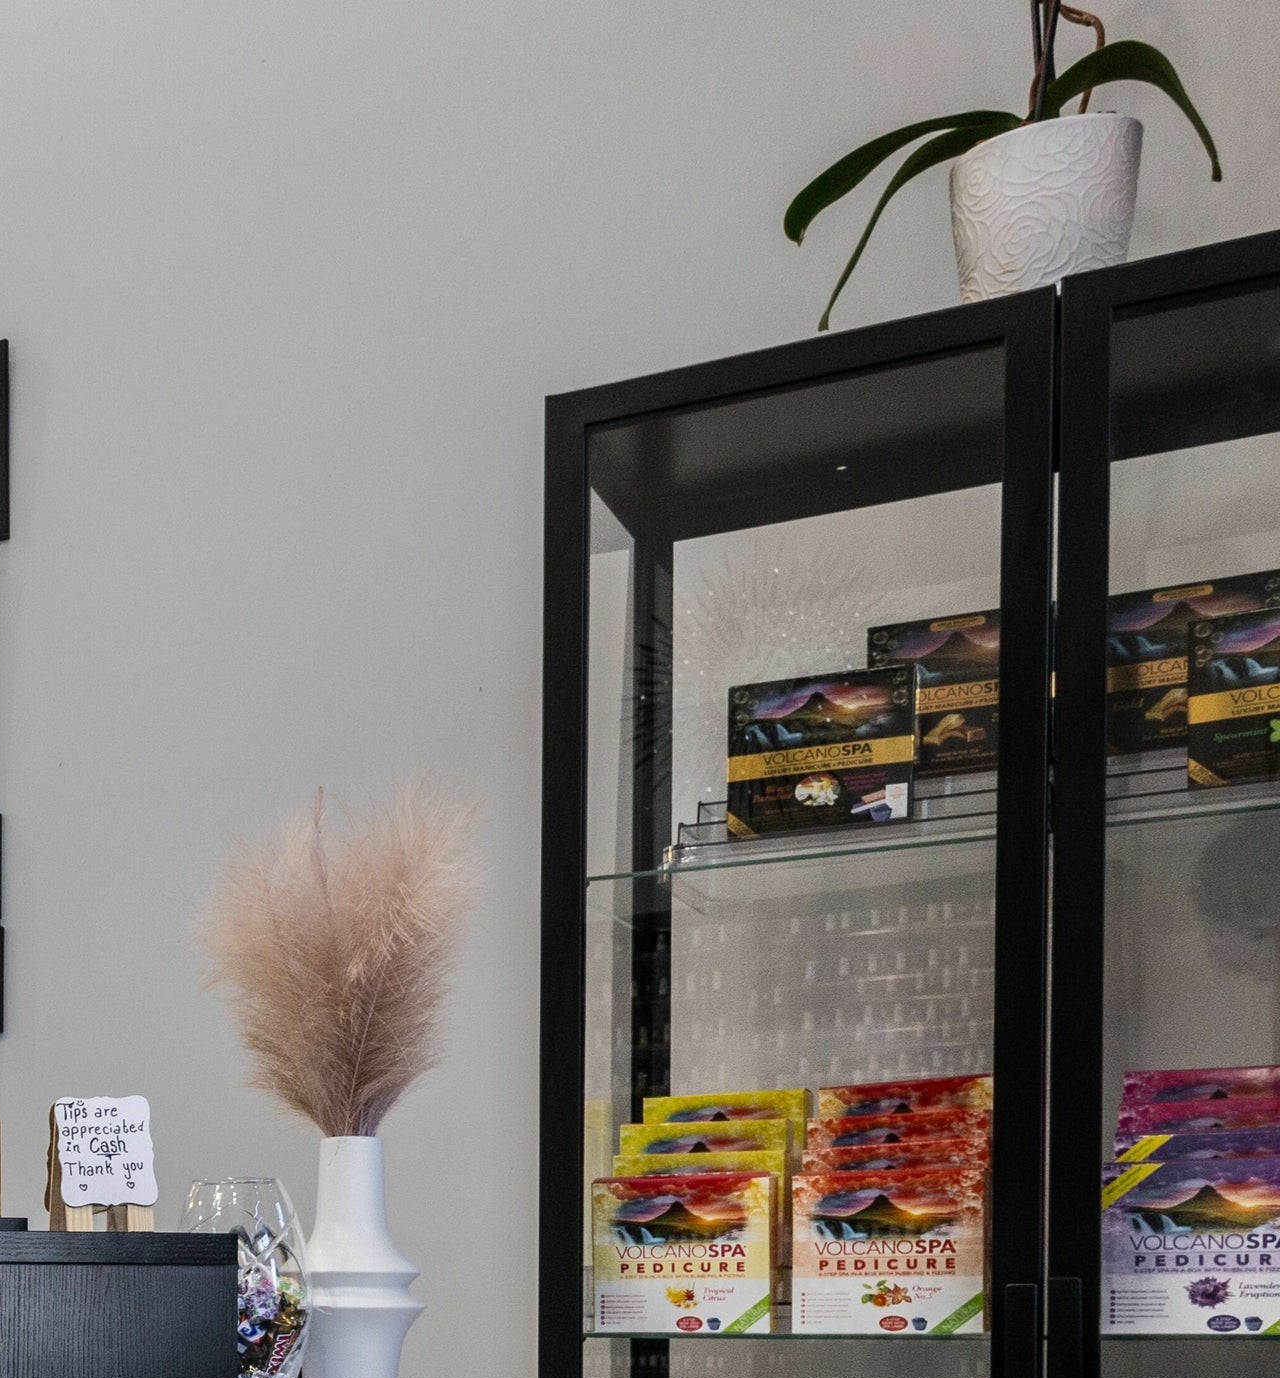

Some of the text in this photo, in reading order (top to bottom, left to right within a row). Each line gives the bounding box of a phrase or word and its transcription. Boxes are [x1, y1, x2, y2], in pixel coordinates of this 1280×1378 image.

[919, 682, 999, 701] OLCANOS
[1213, 727, 1268, 744] Spearmint
[762, 742, 873, 766] VOLCANOSPA
[793, 761, 832, 772] MANICURE
[837, 757, 873, 769] PEDICURE
[56, 1101, 118, 1123] Tips are
[62, 1119, 144, 1140] appreciated
[66, 1135, 128, 1154] in Cash
[64, 1161, 144, 1180] Thank you
[616, 1243, 746, 1259] VOLCANOSPA
[815, 1239, 956, 1256] VOLCANOSPA
[620, 1261, 746, 1274] PEDICURE
[819, 1258, 956, 1271] PEDICURE
[1134, 1253, 1272, 1267] PEDICUR
[703, 1287, 734, 1296] Tropical
[912, 1285, 942, 1294] Orange
[1238, 1282, 1280, 1290] Lavender
[1239, 1291, 1280, 1299] Eruption
[942, 1303, 979, 1332] NATURAL
[266, 1329, 296, 1375] TWIX
